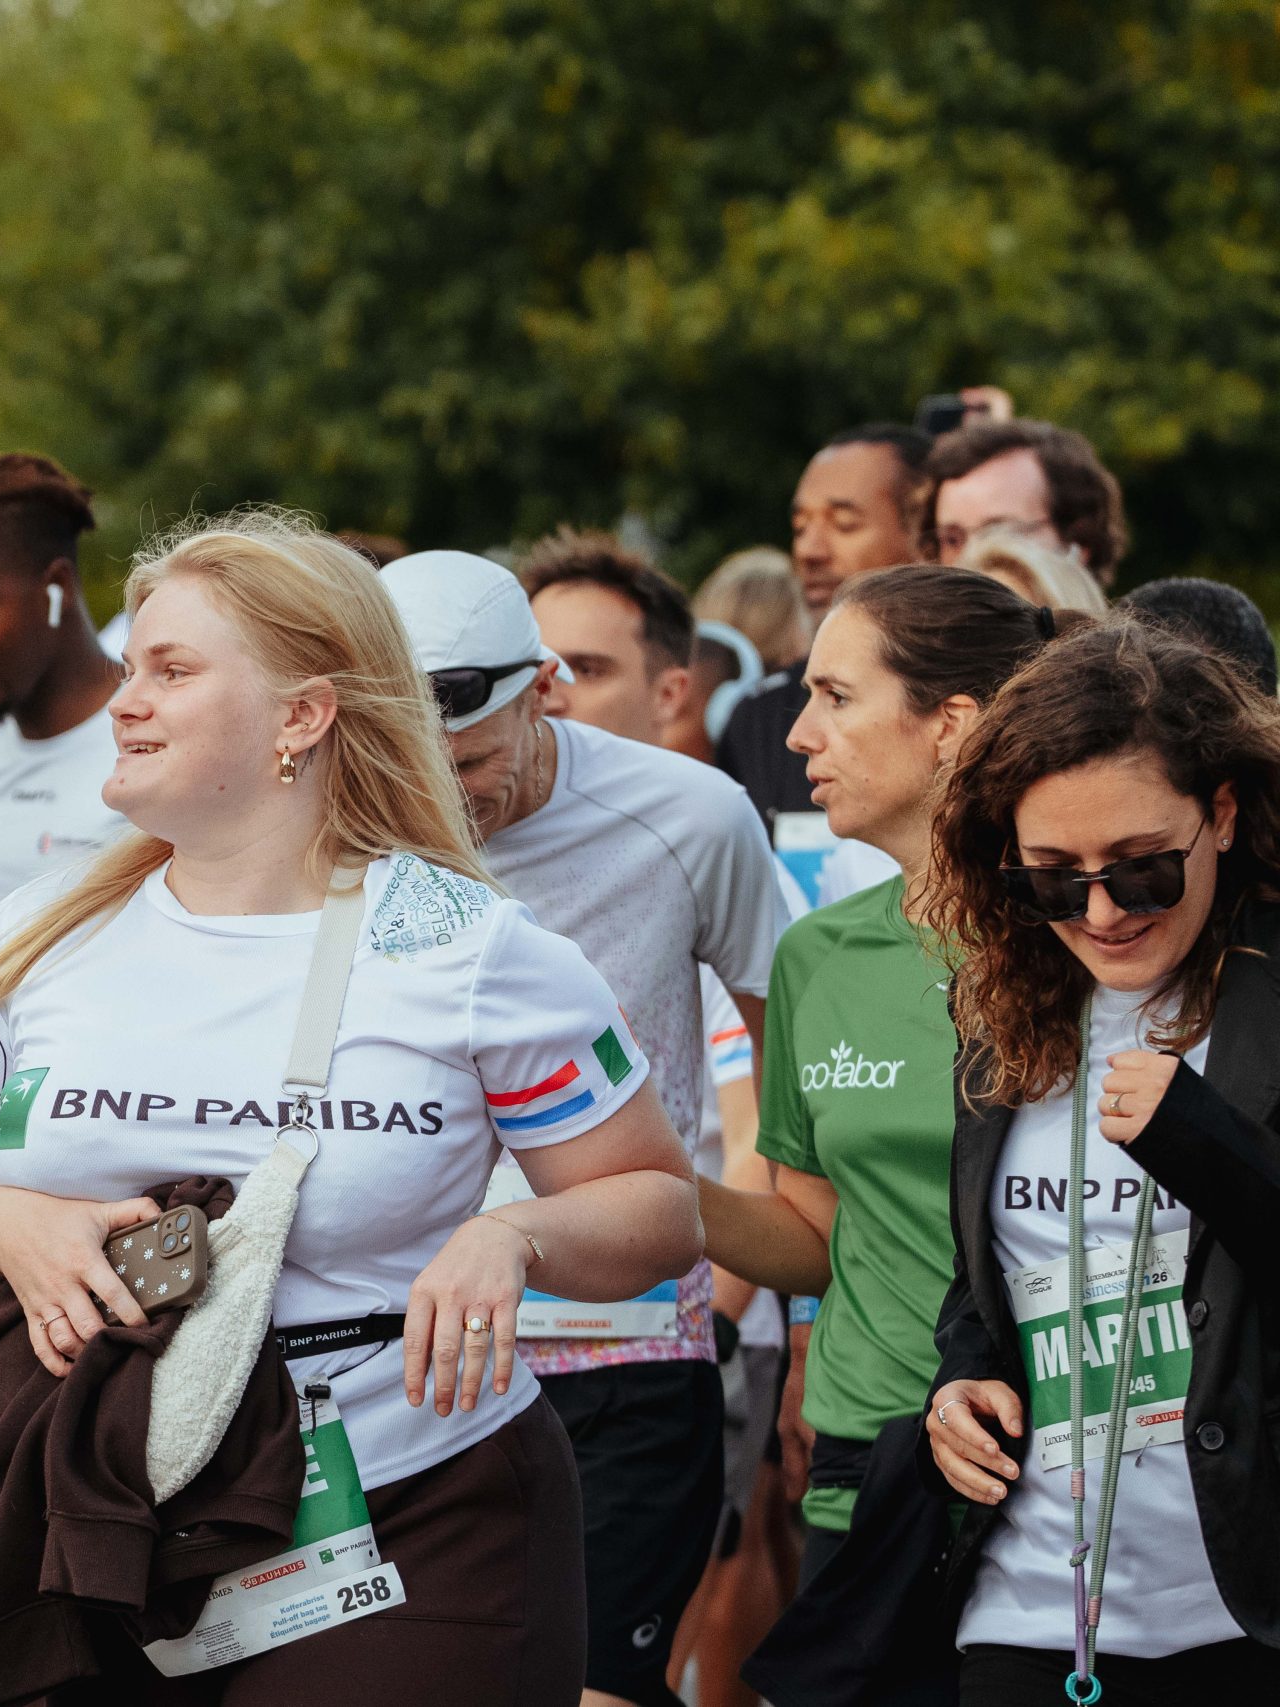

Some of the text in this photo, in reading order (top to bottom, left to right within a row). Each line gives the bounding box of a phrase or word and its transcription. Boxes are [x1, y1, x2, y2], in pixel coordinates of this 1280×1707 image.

[801, 1052, 906, 1092] co-labor
[50, 1088, 444, 1137] BNP PARIBAS
[1004, 1175, 1101, 1213] BNP
[1151, 1271, 1168, 1285] 26
[289, 1326, 361, 1348] BNP PARIBAS
[334, 1546, 350, 1556] BNP
[250, 1560, 305, 1587] BAUHAUS
[337, 1575, 391, 1614] 258
[272, 1603, 328, 1628] Pull-off bag tag
